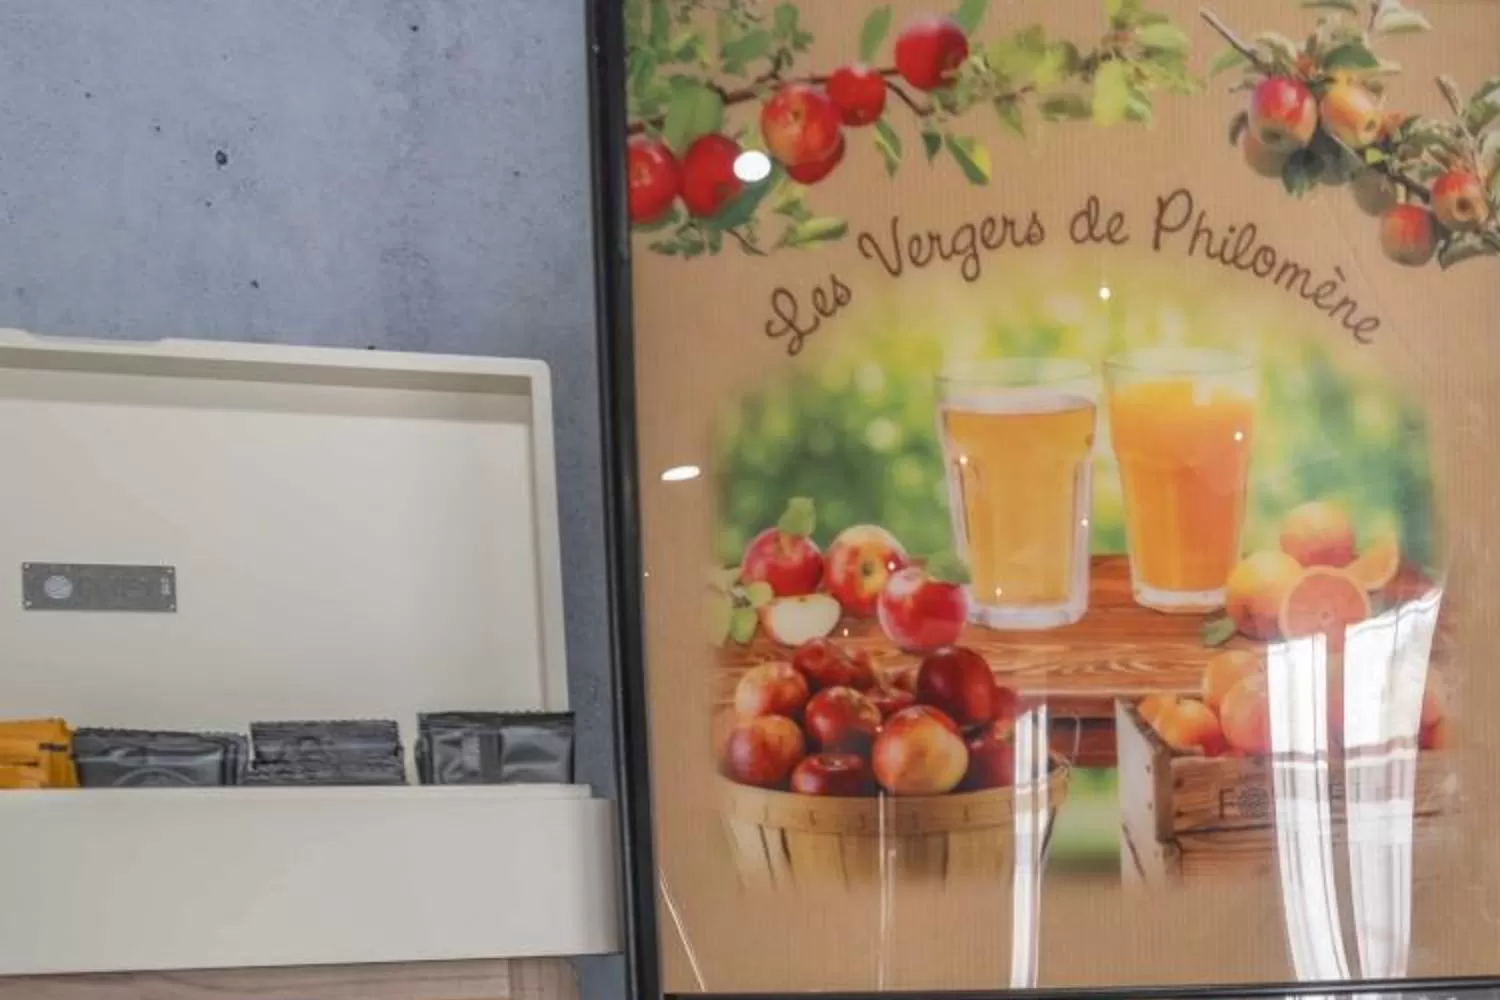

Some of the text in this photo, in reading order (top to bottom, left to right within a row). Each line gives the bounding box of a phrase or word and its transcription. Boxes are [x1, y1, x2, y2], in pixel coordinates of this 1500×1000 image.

[765, 187, 1381, 356] Les Vergers de Philomène
